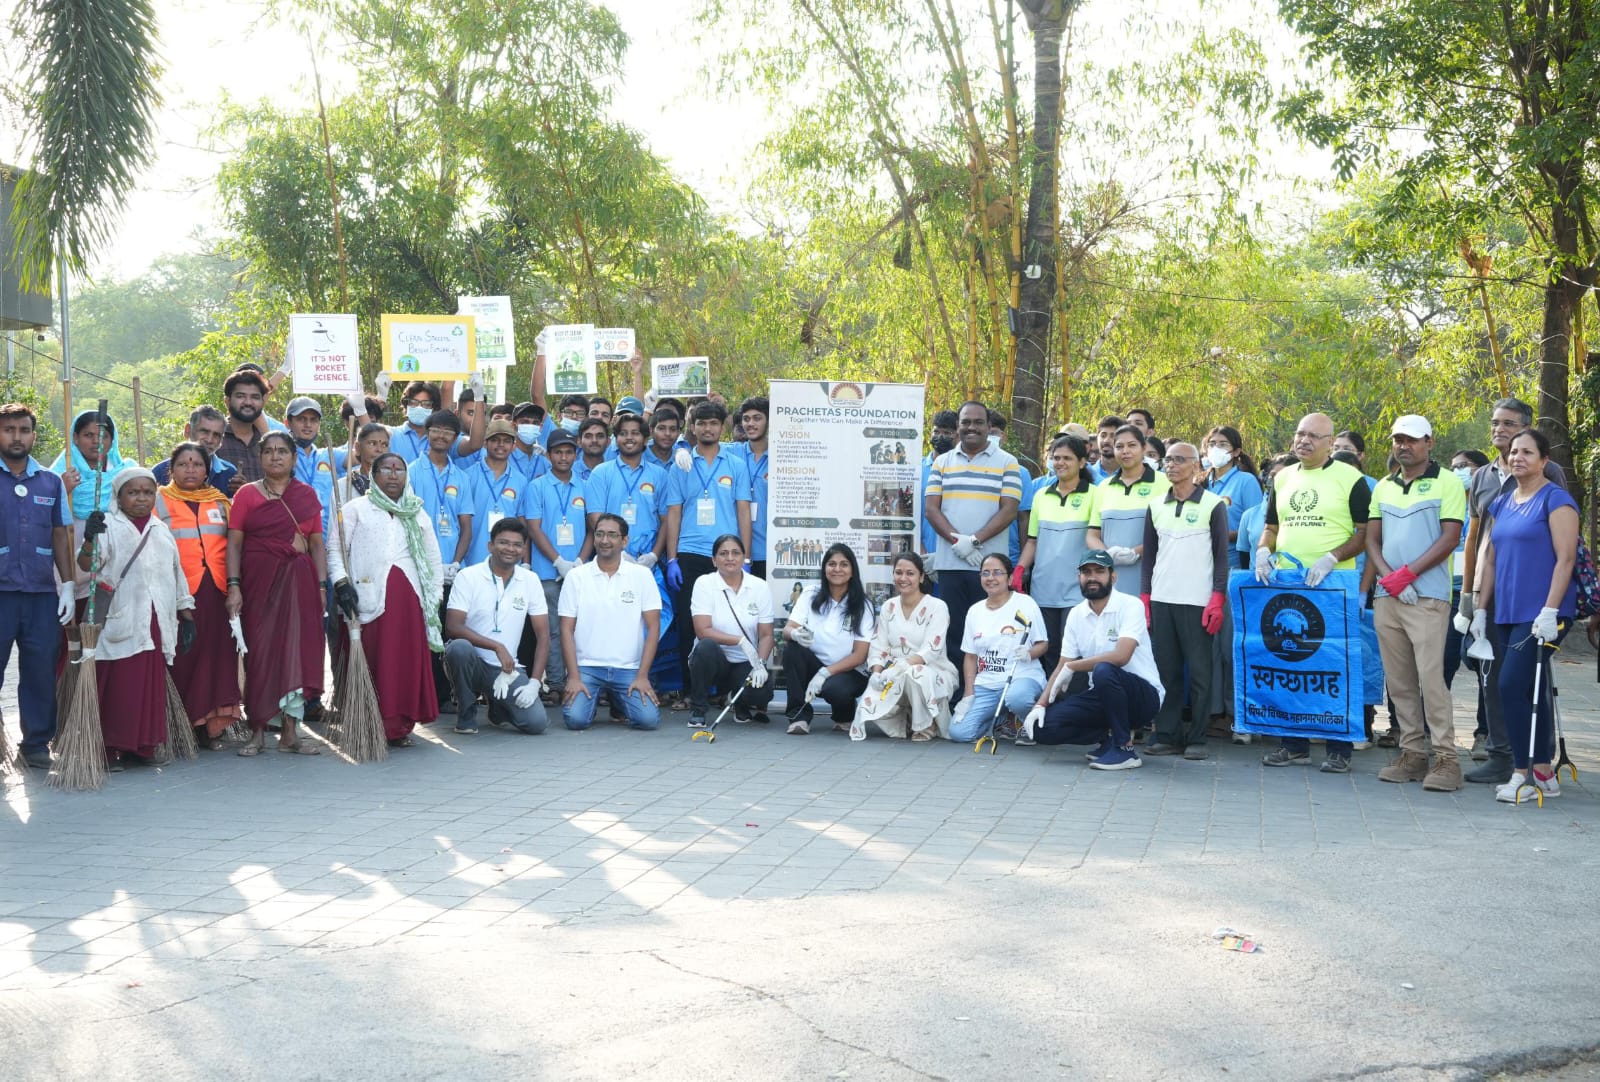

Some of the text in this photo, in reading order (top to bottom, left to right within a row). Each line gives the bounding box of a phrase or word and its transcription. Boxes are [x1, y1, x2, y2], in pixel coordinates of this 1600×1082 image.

[315, 364, 346, 372] ROCKET
[660, 363, 680, 371] CLEAN
[776, 406, 916, 419] PRACHETAS FOUNDATION
[789, 416, 818, 424] Together
[779, 431, 811, 439] VISION
[776, 466, 816, 475] MISSION
[1250, 664, 1341, 698] स्वच्छाग्रह
[1289, 710, 1344, 725] महानगरपालिका
